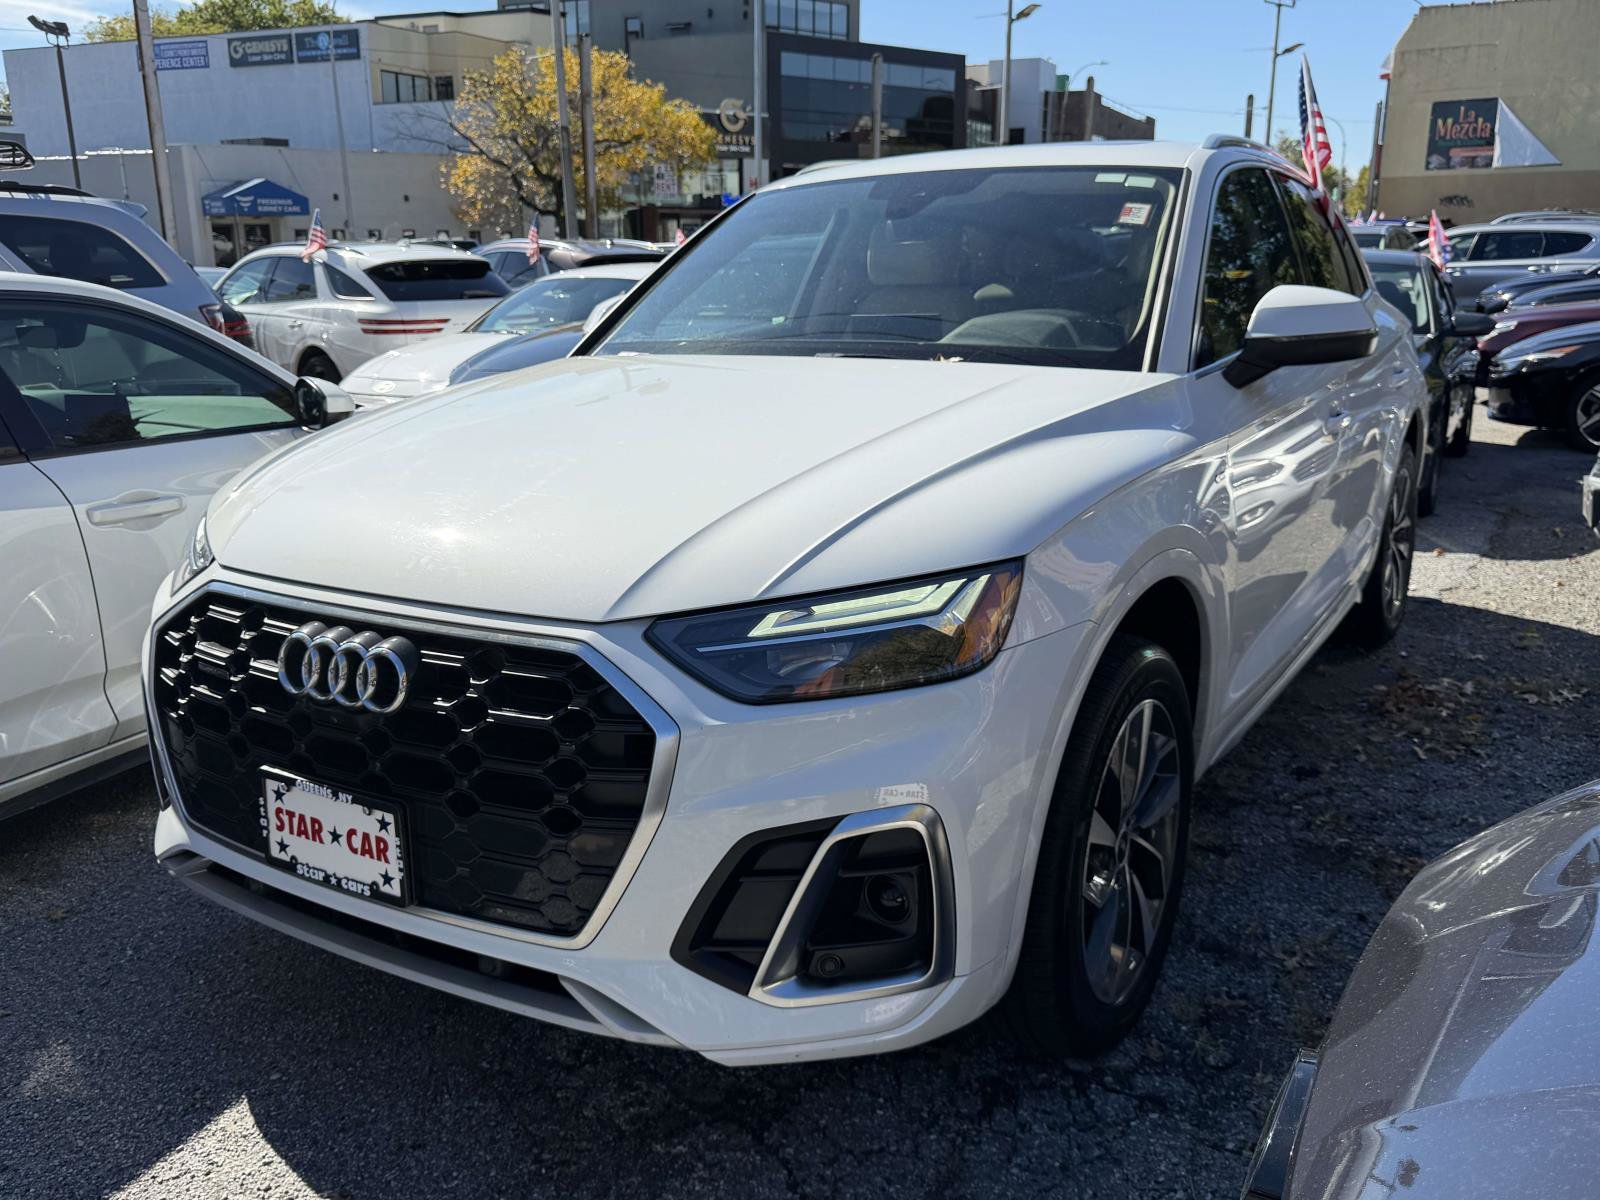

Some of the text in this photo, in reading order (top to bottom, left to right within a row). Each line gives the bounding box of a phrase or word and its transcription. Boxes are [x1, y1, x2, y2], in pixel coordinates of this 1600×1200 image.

[244, 39, 289, 54] GENESYS
[1458, 106, 1476, 123] La
[1436, 118, 1491, 140] Mezcla
[295, 780, 353, 805] QUEENS, NY
[258, 796, 269, 838] star
[274, 806, 391, 864] STAR CAR
[296, 862, 371, 897] star cars
